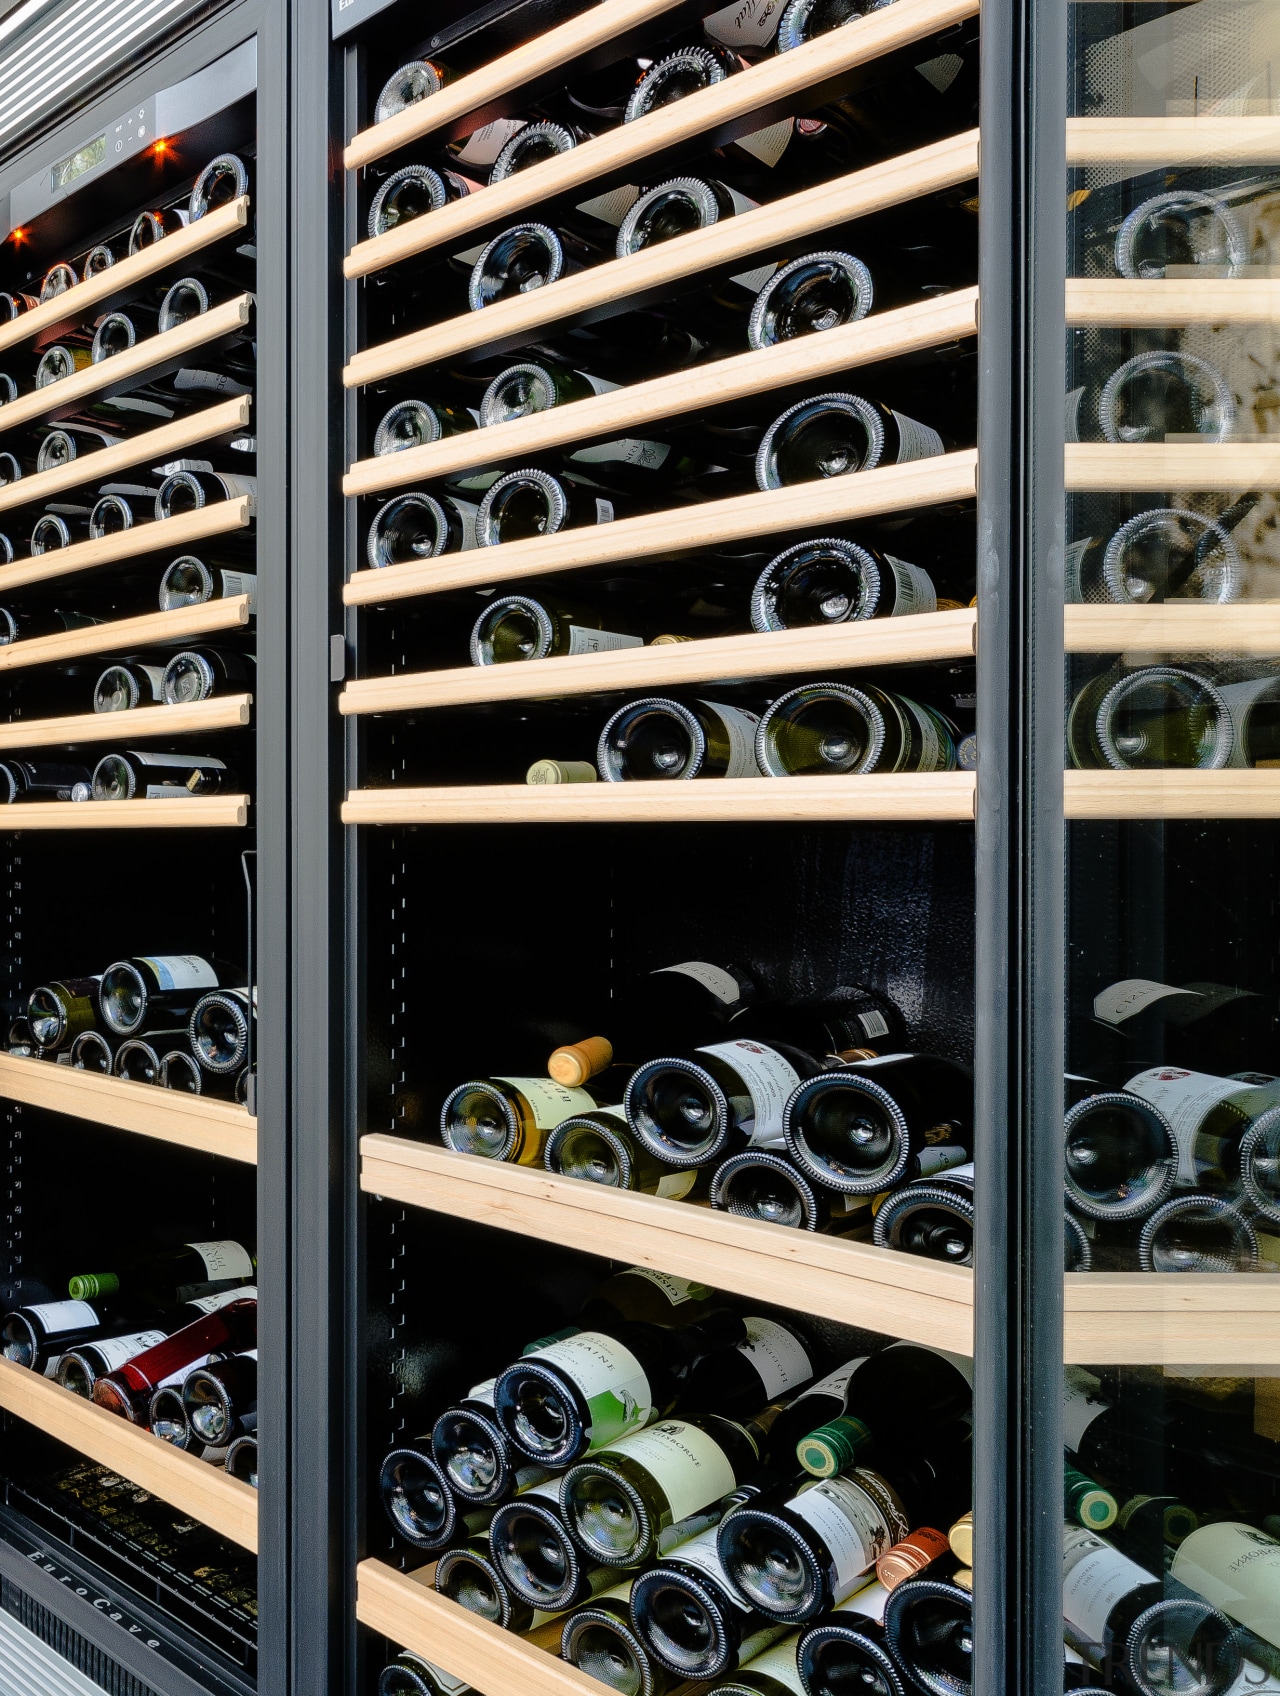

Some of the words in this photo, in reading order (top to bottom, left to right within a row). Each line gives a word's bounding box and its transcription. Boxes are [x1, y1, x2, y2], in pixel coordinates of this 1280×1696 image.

[652, 1431, 702, 1468] GISBORNE
[827, 1506, 857, 1549] CHARDONNAY
[26, 1551, 161, 1649] EuroCave
